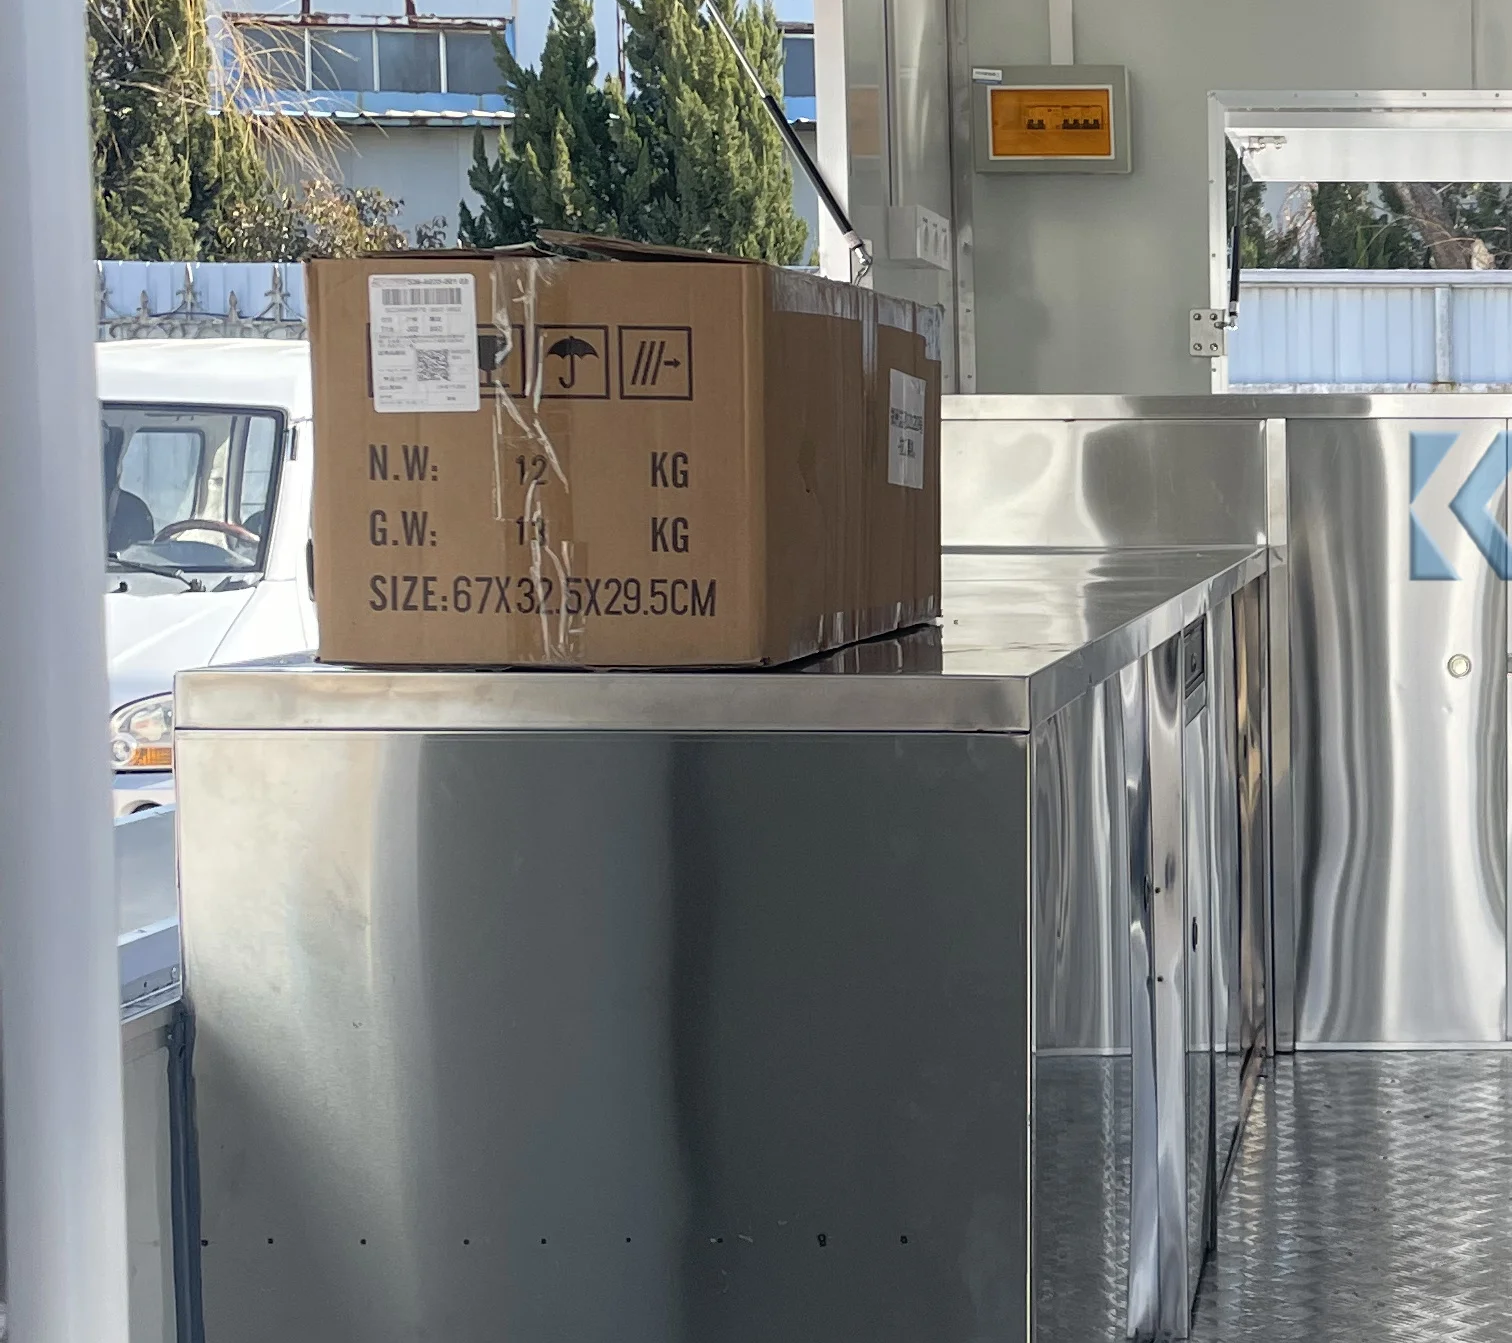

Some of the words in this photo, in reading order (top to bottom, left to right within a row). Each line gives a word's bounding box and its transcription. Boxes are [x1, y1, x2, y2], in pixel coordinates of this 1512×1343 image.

[369, 444, 439, 481] N.W:
[516, 455, 548, 485] 12
[651, 451, 690, 488] KG
[369, 509, 438, 546] G.W:
[651, 517, 690, 553] KG
